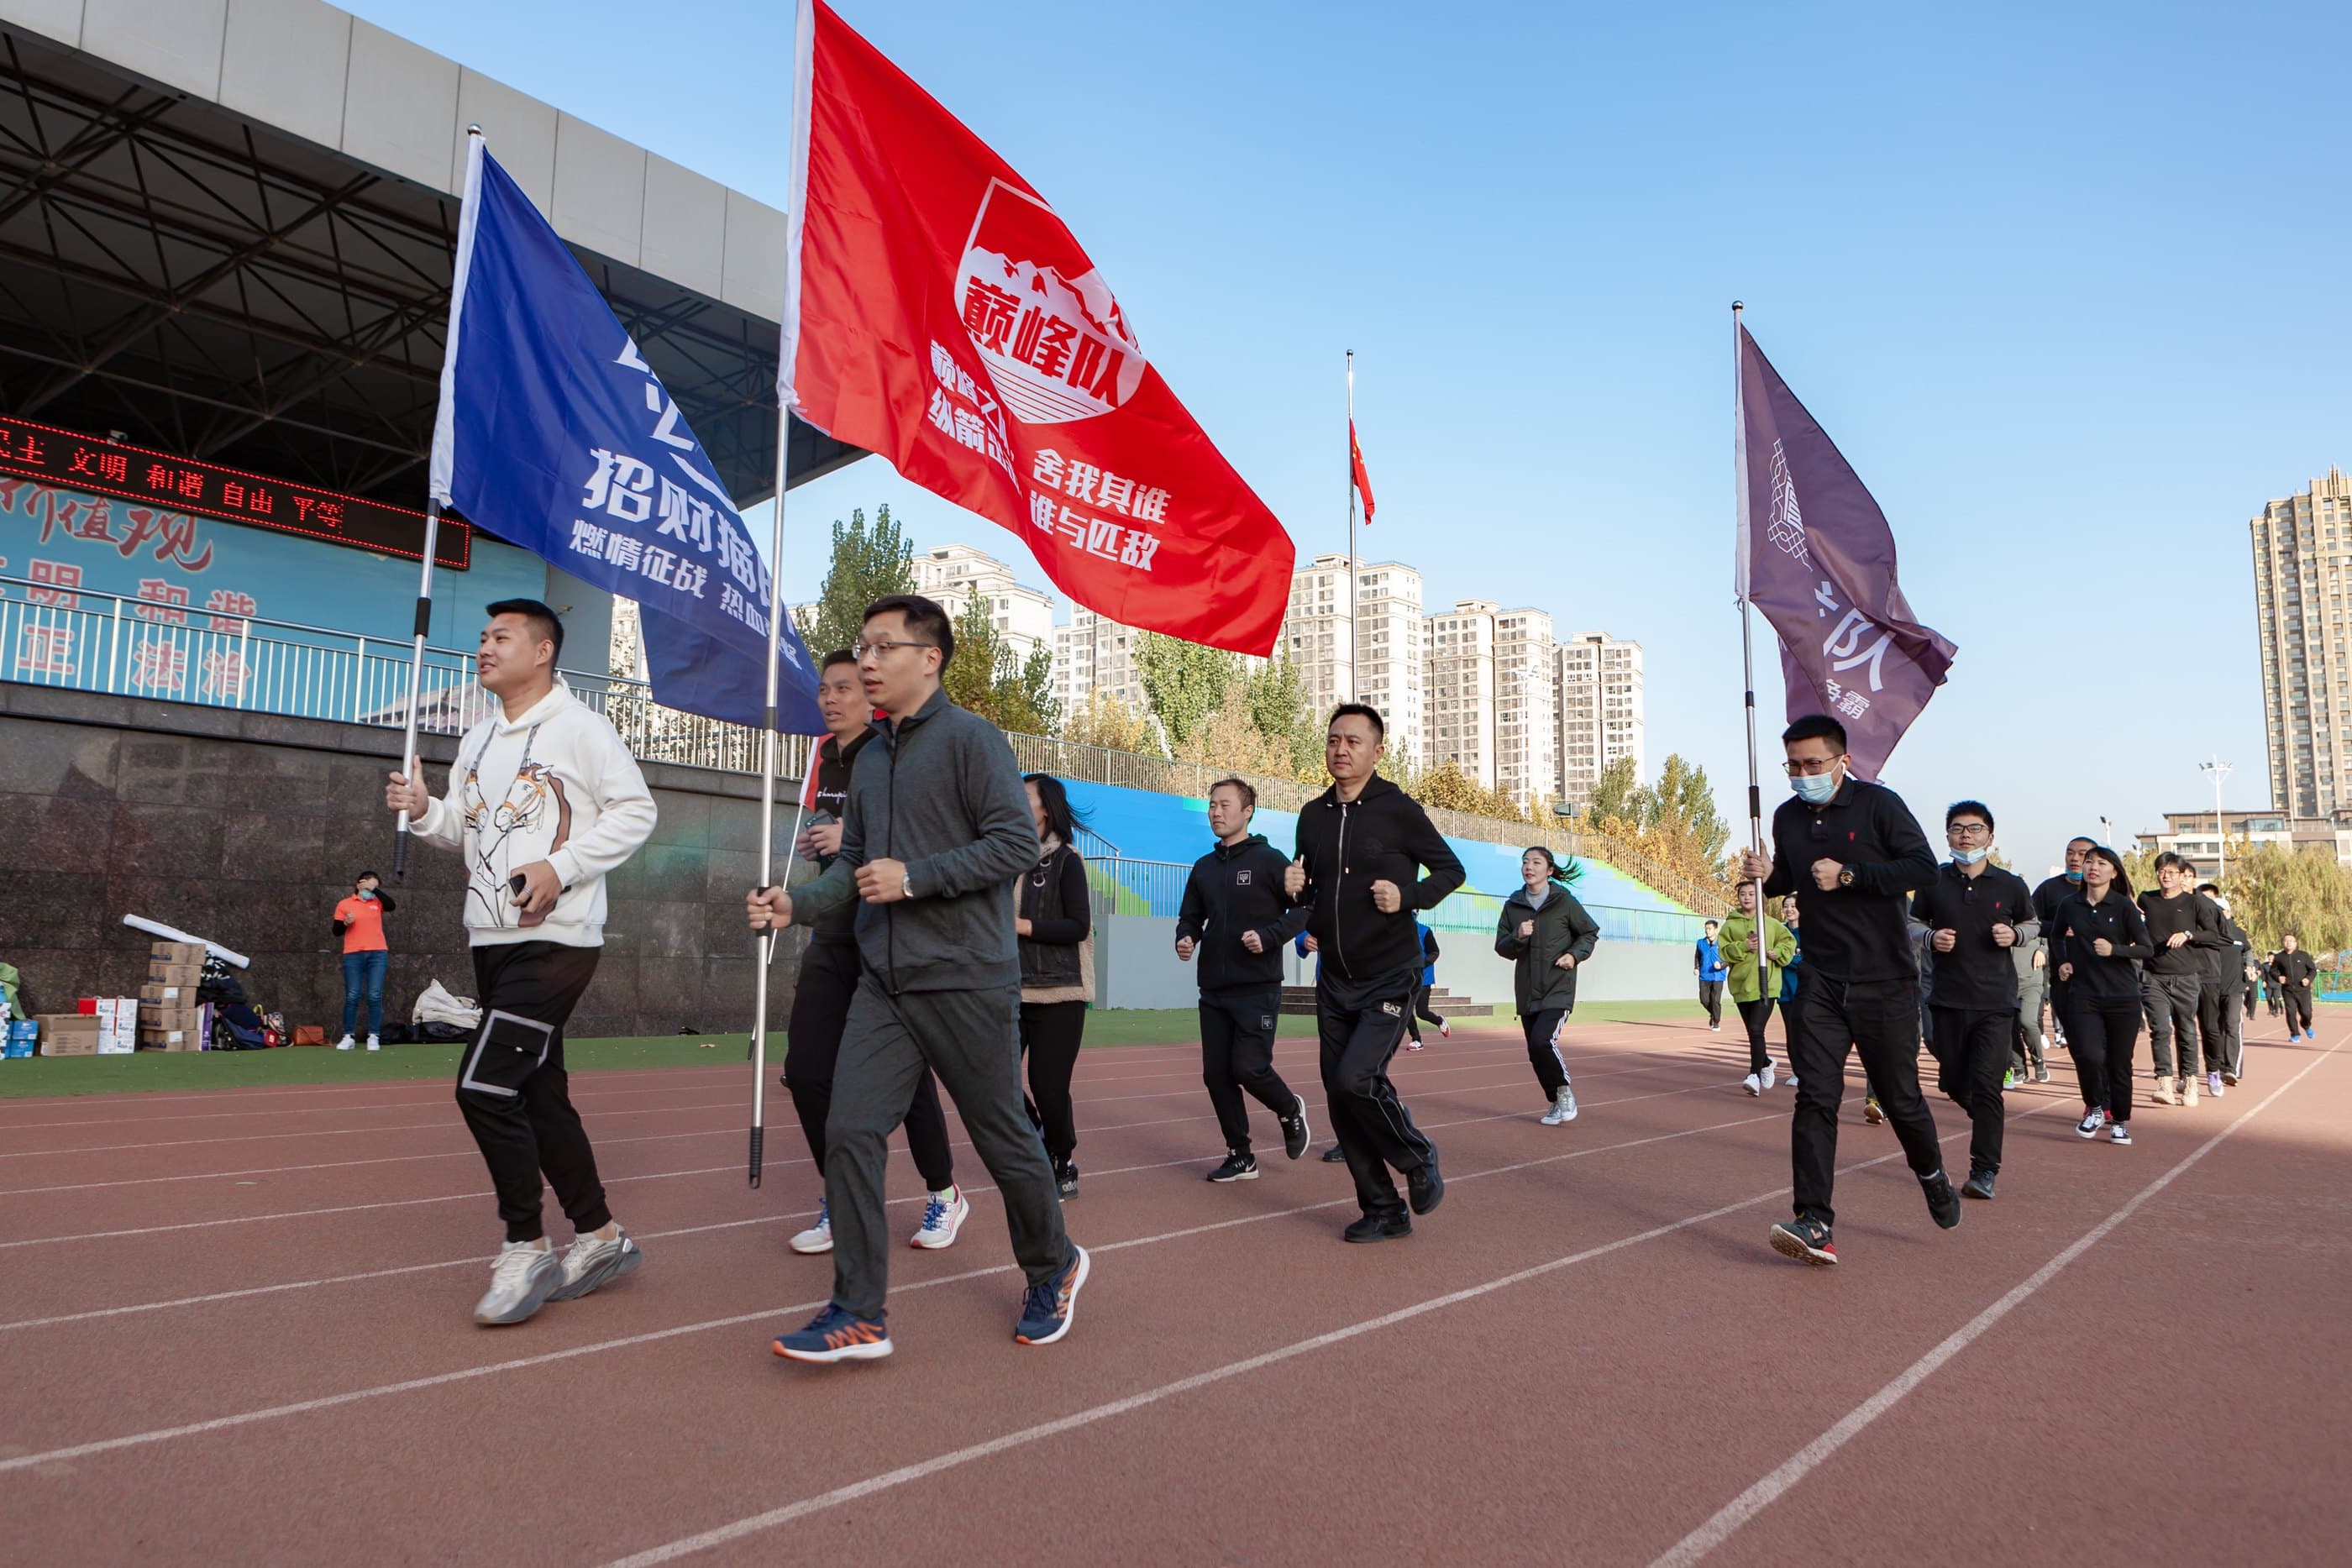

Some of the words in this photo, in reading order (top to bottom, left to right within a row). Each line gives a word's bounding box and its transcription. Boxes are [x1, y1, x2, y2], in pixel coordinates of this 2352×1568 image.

[963, 275, 1126, 408] 巅峰队
[930, 338, 1014, 462] 巅峰之
[1032, 448, 1172, 526] 舍我其谁
[68, 447, 128, 483] 文明
[146, 463, 204, 499] 和谐
[569, 518, 709, 599] 燃情征战
[1030, 490, 1162, 572] 谁与匹敌
[133, 578, 257, 637] 和谐
[132, 640, 252, 700] 法治
[1383, 1001, 1402, 1015] EA7
